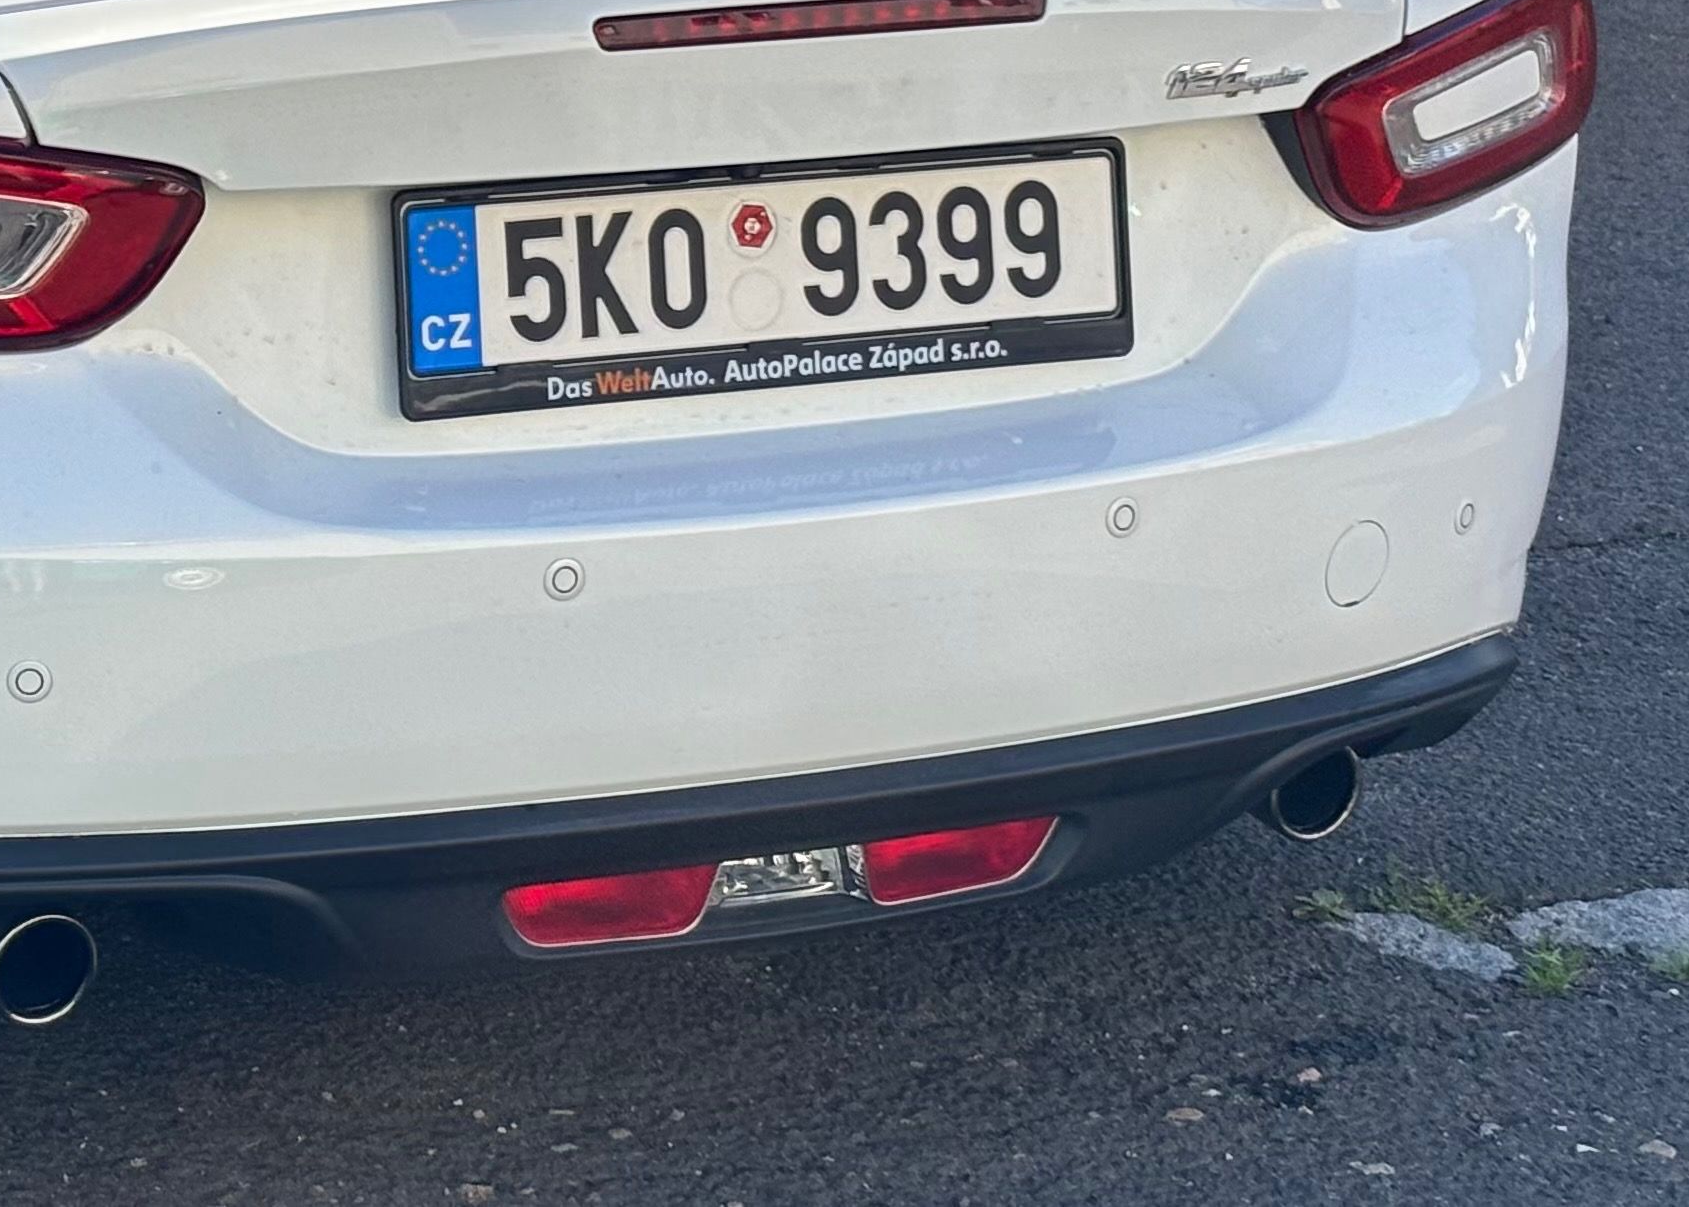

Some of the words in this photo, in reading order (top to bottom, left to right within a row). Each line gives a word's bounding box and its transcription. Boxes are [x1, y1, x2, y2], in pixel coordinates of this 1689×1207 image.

[800, 180, 1062, 317] 9399
[421, 314, 473, 352] CZ
[546, 377, 593, 401] Das
[724, 350, 864, 384] AutoPalace
[869, 338, 945, 372] Západ
[950, 339, 1009, 362] s.r.o.
